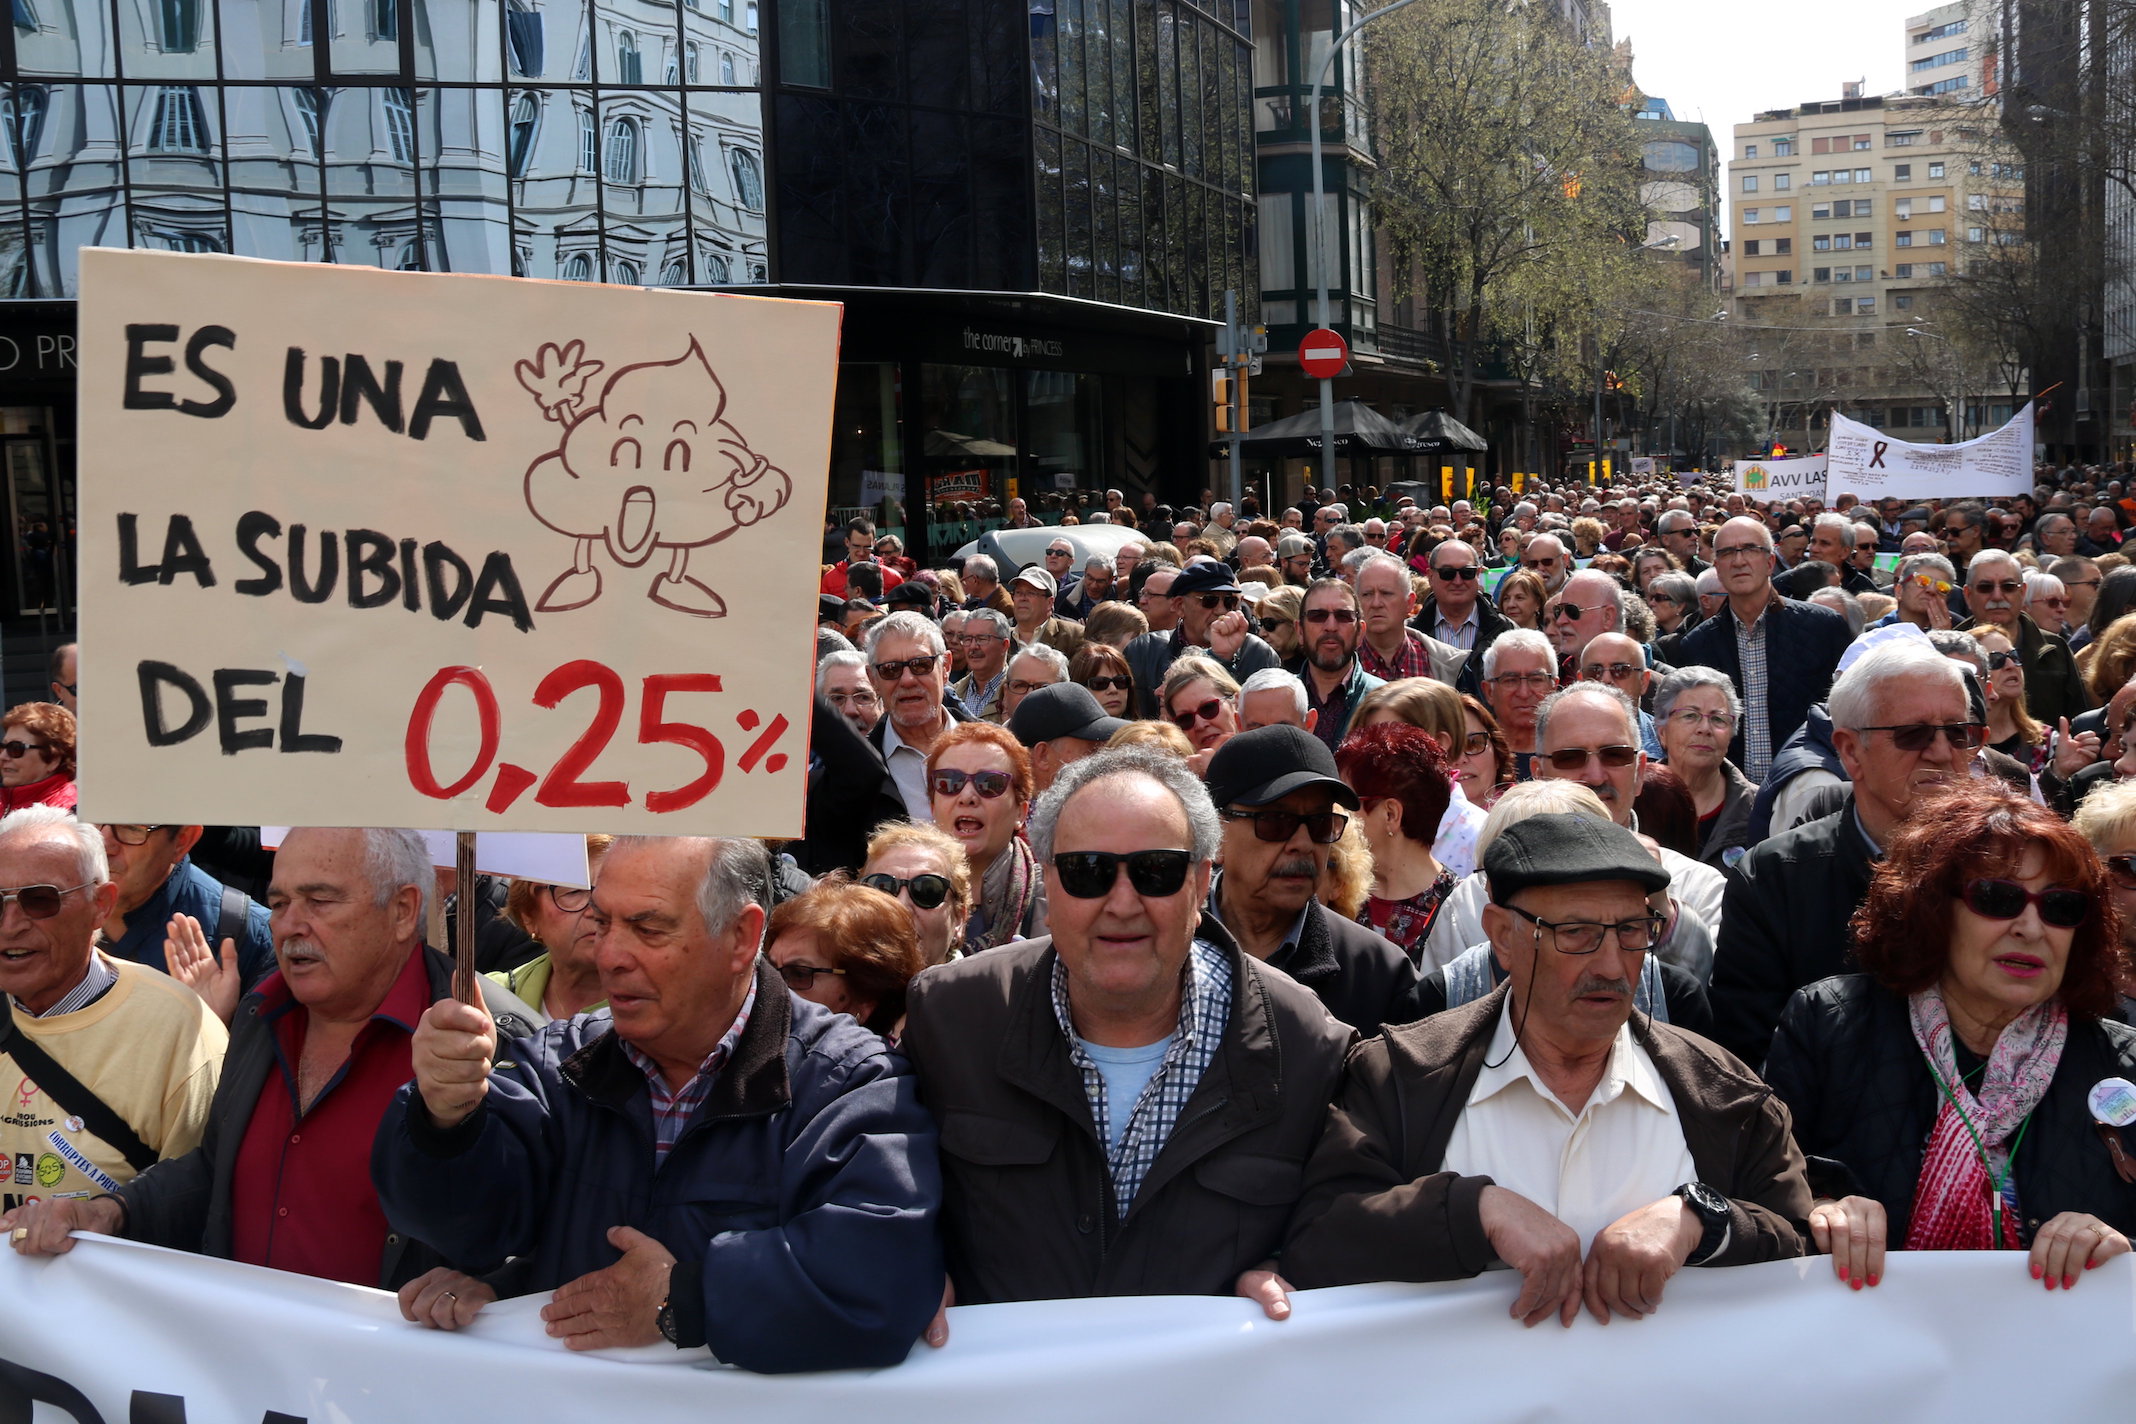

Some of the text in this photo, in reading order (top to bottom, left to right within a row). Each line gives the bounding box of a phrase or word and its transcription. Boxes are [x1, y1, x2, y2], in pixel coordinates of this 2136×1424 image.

[963, 326, 980, 350] the
[982, 333, 1012, 352] corner
[124, 323, 487, 442] ES UNA
[1770, 473, 1801, 487] AVV
[117, 511, 535, 632] LA SUBIDA
[137, 659, 790, 814] DEL 0,25%
[48, 1130, 92, 1173] CORRUPTES
[89, 1168, 98, 1178] A
